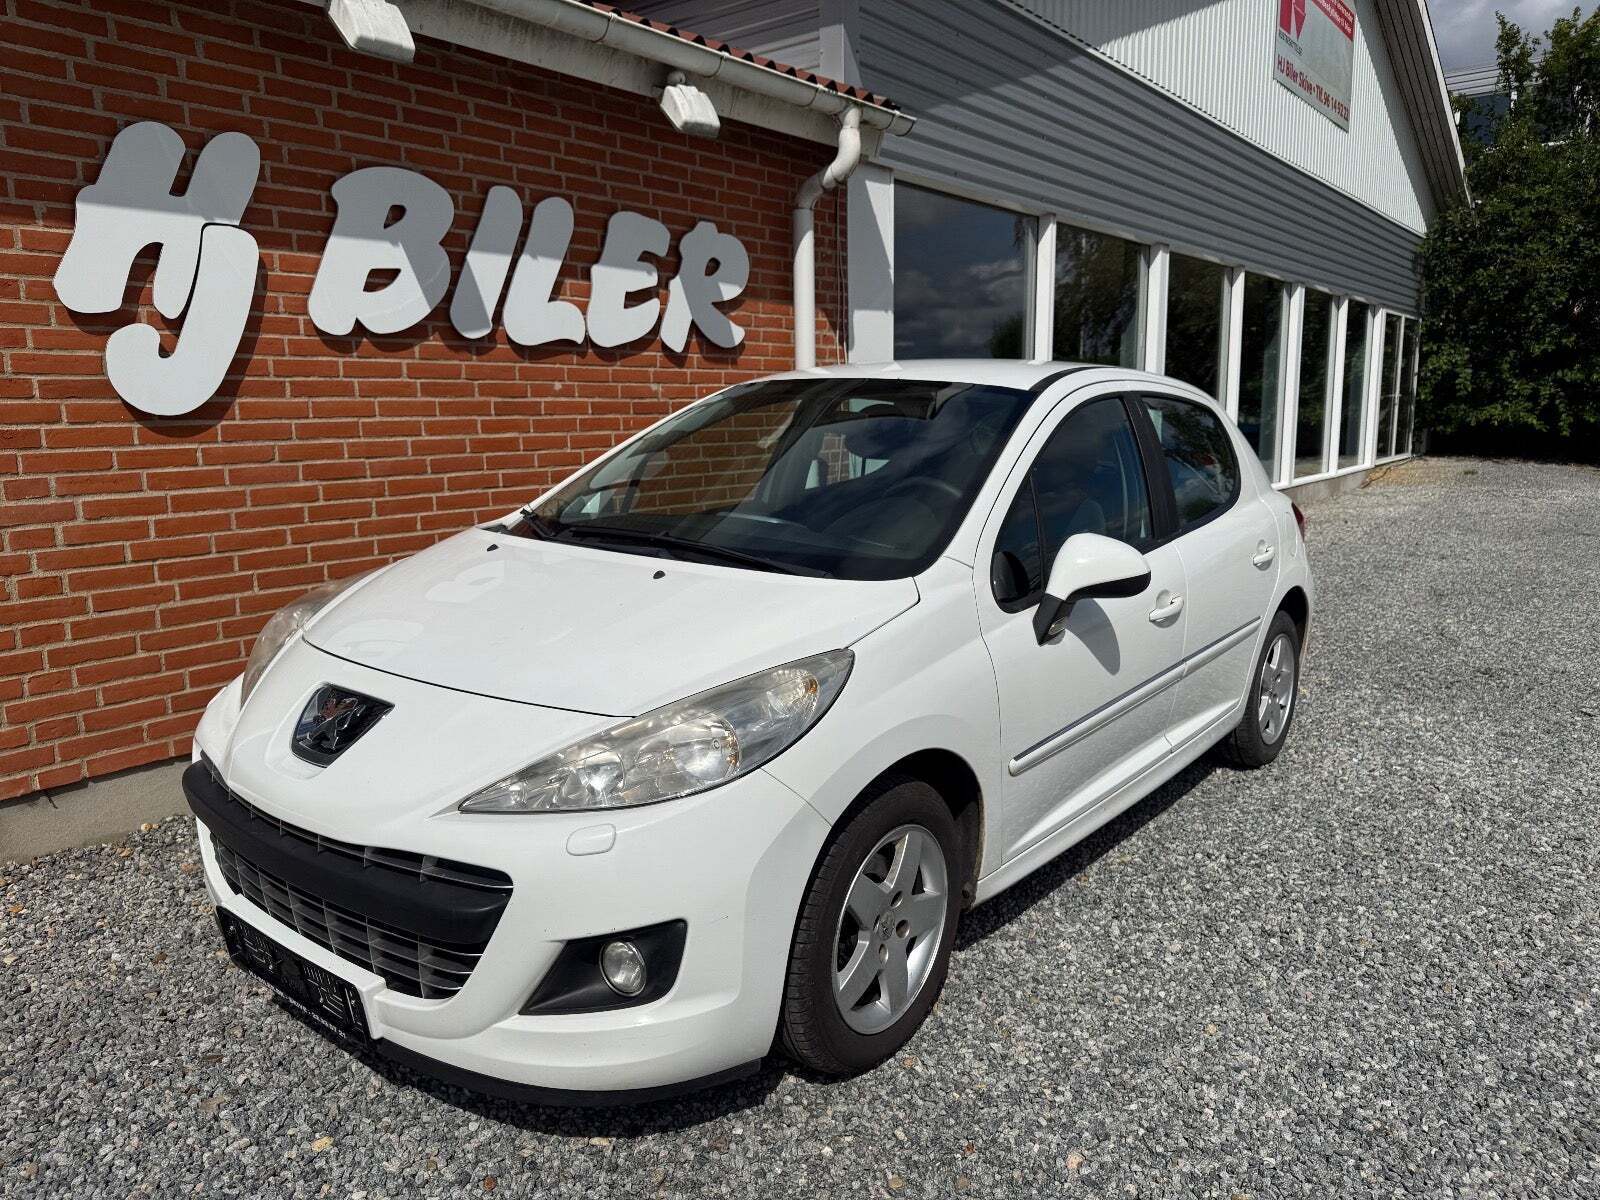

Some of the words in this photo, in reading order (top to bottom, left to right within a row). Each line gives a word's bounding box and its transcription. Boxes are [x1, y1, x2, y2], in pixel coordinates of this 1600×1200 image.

[1277, 54, 1285, 74] HJ
[1286, 61, 1298, 83] Biler
[1299, 71, 1313, 95] Skive
[54, 122, 260, 415] HJ
[308, 166, 750, 352] BILER
